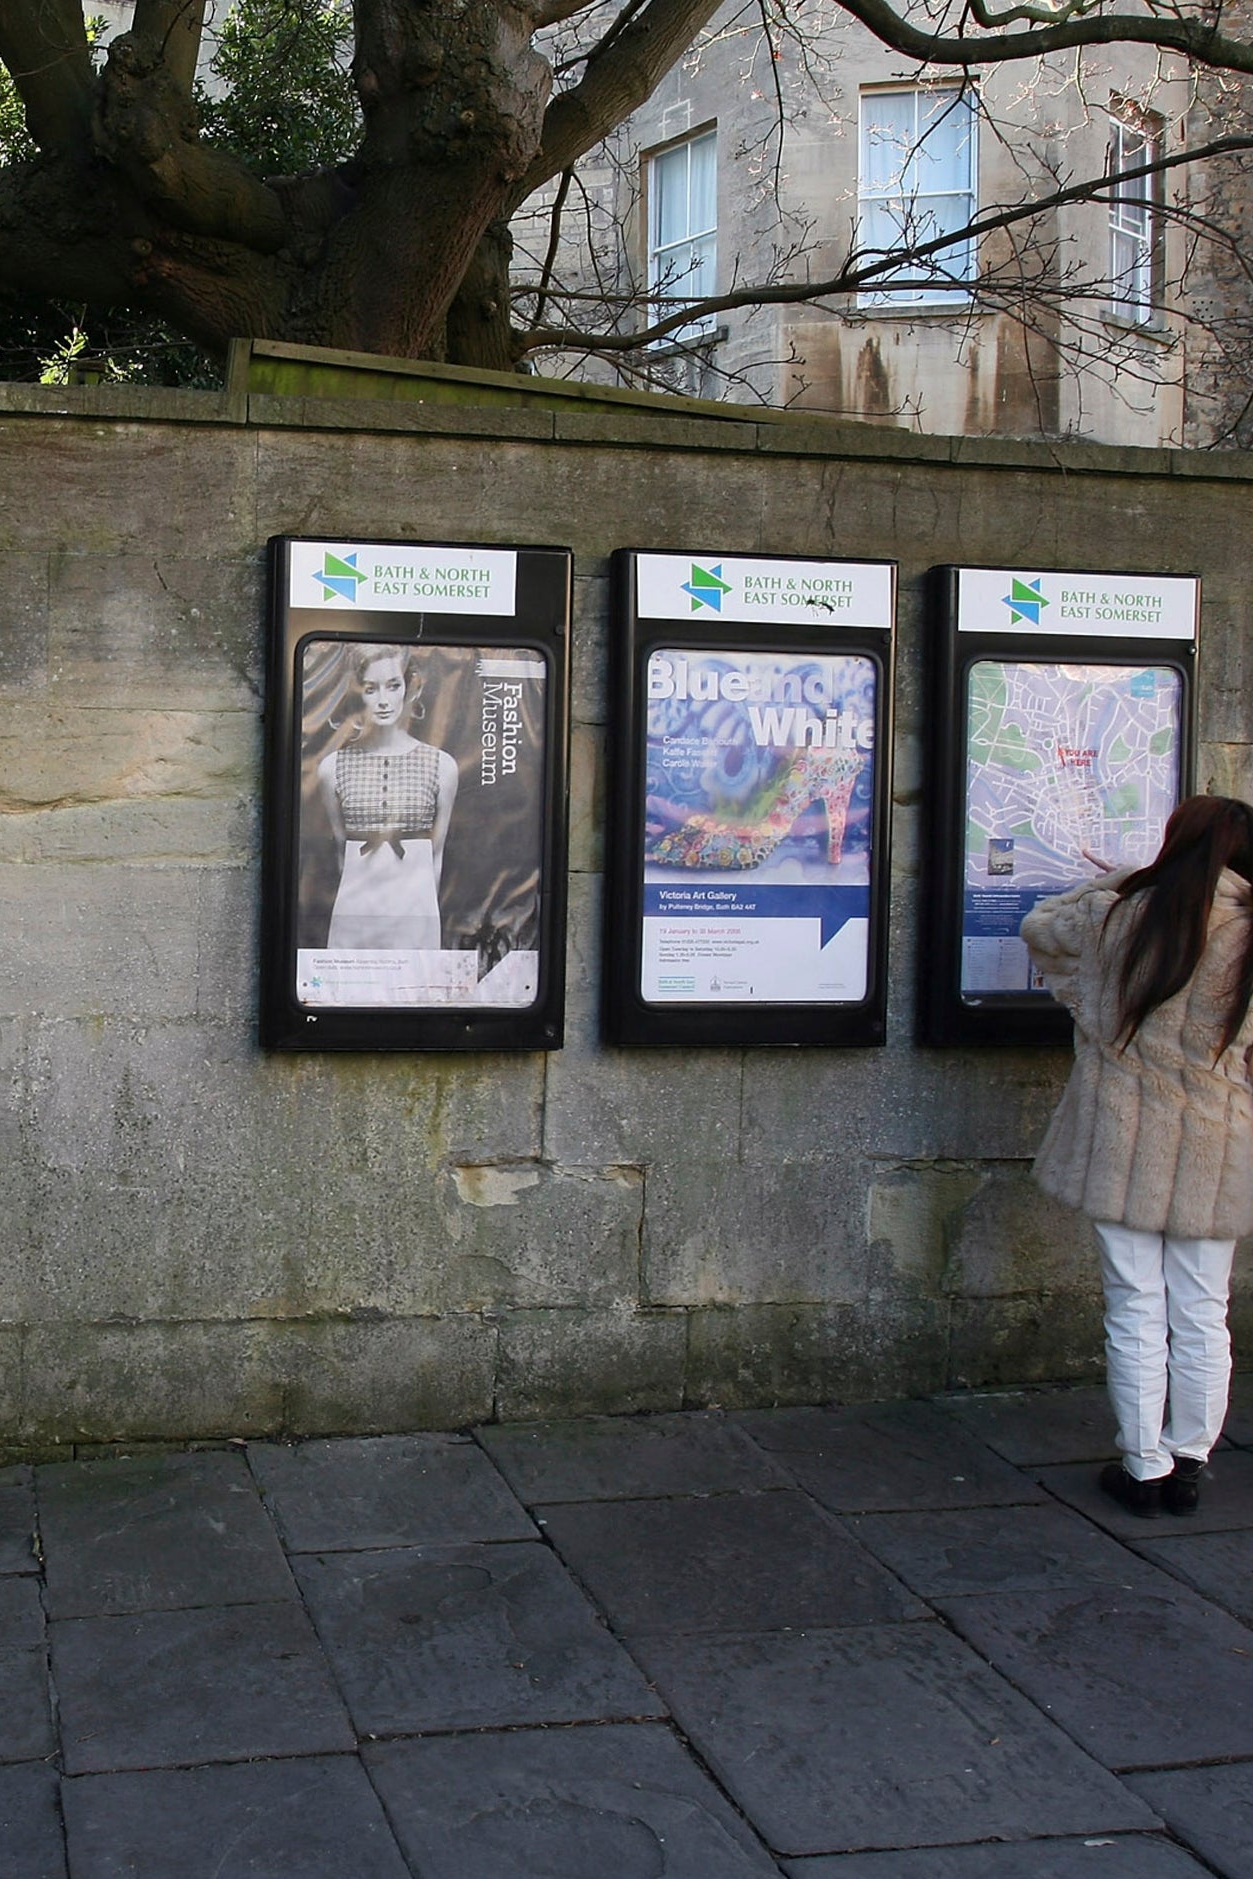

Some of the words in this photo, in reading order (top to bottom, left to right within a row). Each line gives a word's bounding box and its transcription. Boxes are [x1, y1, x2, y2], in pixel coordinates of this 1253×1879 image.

[373, 564, 414, 579] BATH
[419, 566, 430, 580] &
[435, 567, 491, 582] NORTH
[373, 581, 408, 595] EAST
[413, 583, 491, 598] SOMERSET
[744, 575, 782, 589] BATH
[786, 577, 797, 590] &
[801, 578, 853, 592] NORTH
[744, 591, 777, 605] EAST
[1061, 590, 1096, 604] BATH
[1100, 592, 1110, 605] &
[1113, 593, 1162, 608] NORTH
[1060, 605, 1091, 619] EAST
[1095, 607, 1162, 623] SOMERSET
[647, 659, 749, 702] Blue
[481, 682, 502, 786] Museum
[502, 682, 523, 775] Fashion
[748, 706, 875, 749] White
[659, 891, 690, 900] Victoria
[692, 891, 705, 900] Art
[707, 892, 737, 902] Gallery
